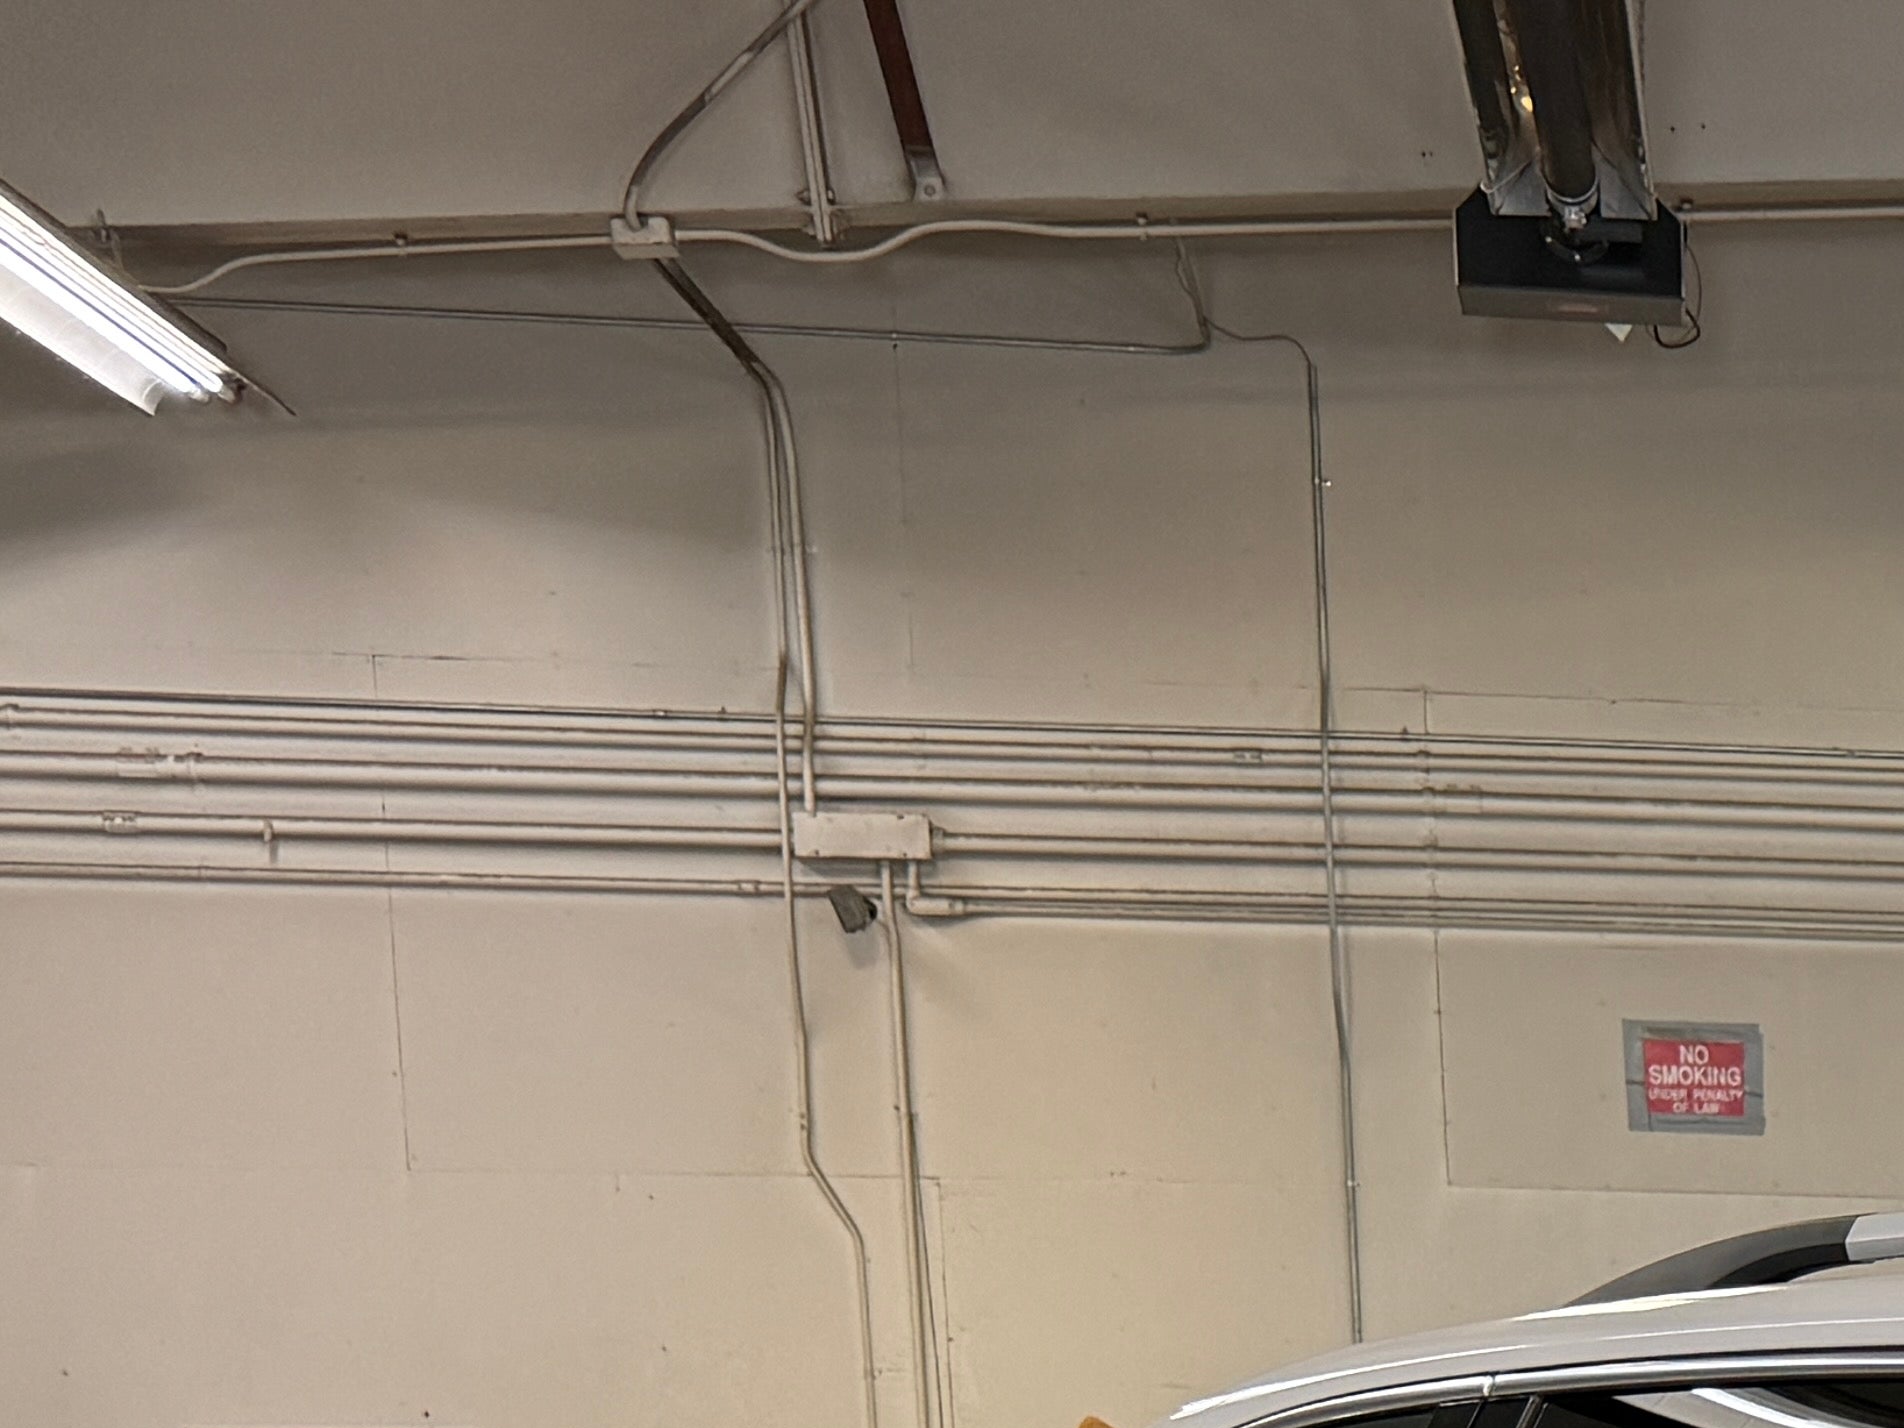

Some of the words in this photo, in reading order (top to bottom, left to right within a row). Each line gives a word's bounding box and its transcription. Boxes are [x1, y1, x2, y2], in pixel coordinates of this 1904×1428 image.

[1679, 1045, 1709, 1065] NO
[1648, 1064, 1742, 1087] SMOKING
[1648, 1087, 1688, 1101] UNDER
[1693, 1088, 1743, 1102] PENALTY
[1673, 1102, 1688, 1113] OF
[1694, 1102, 1720, 1114] LAW
